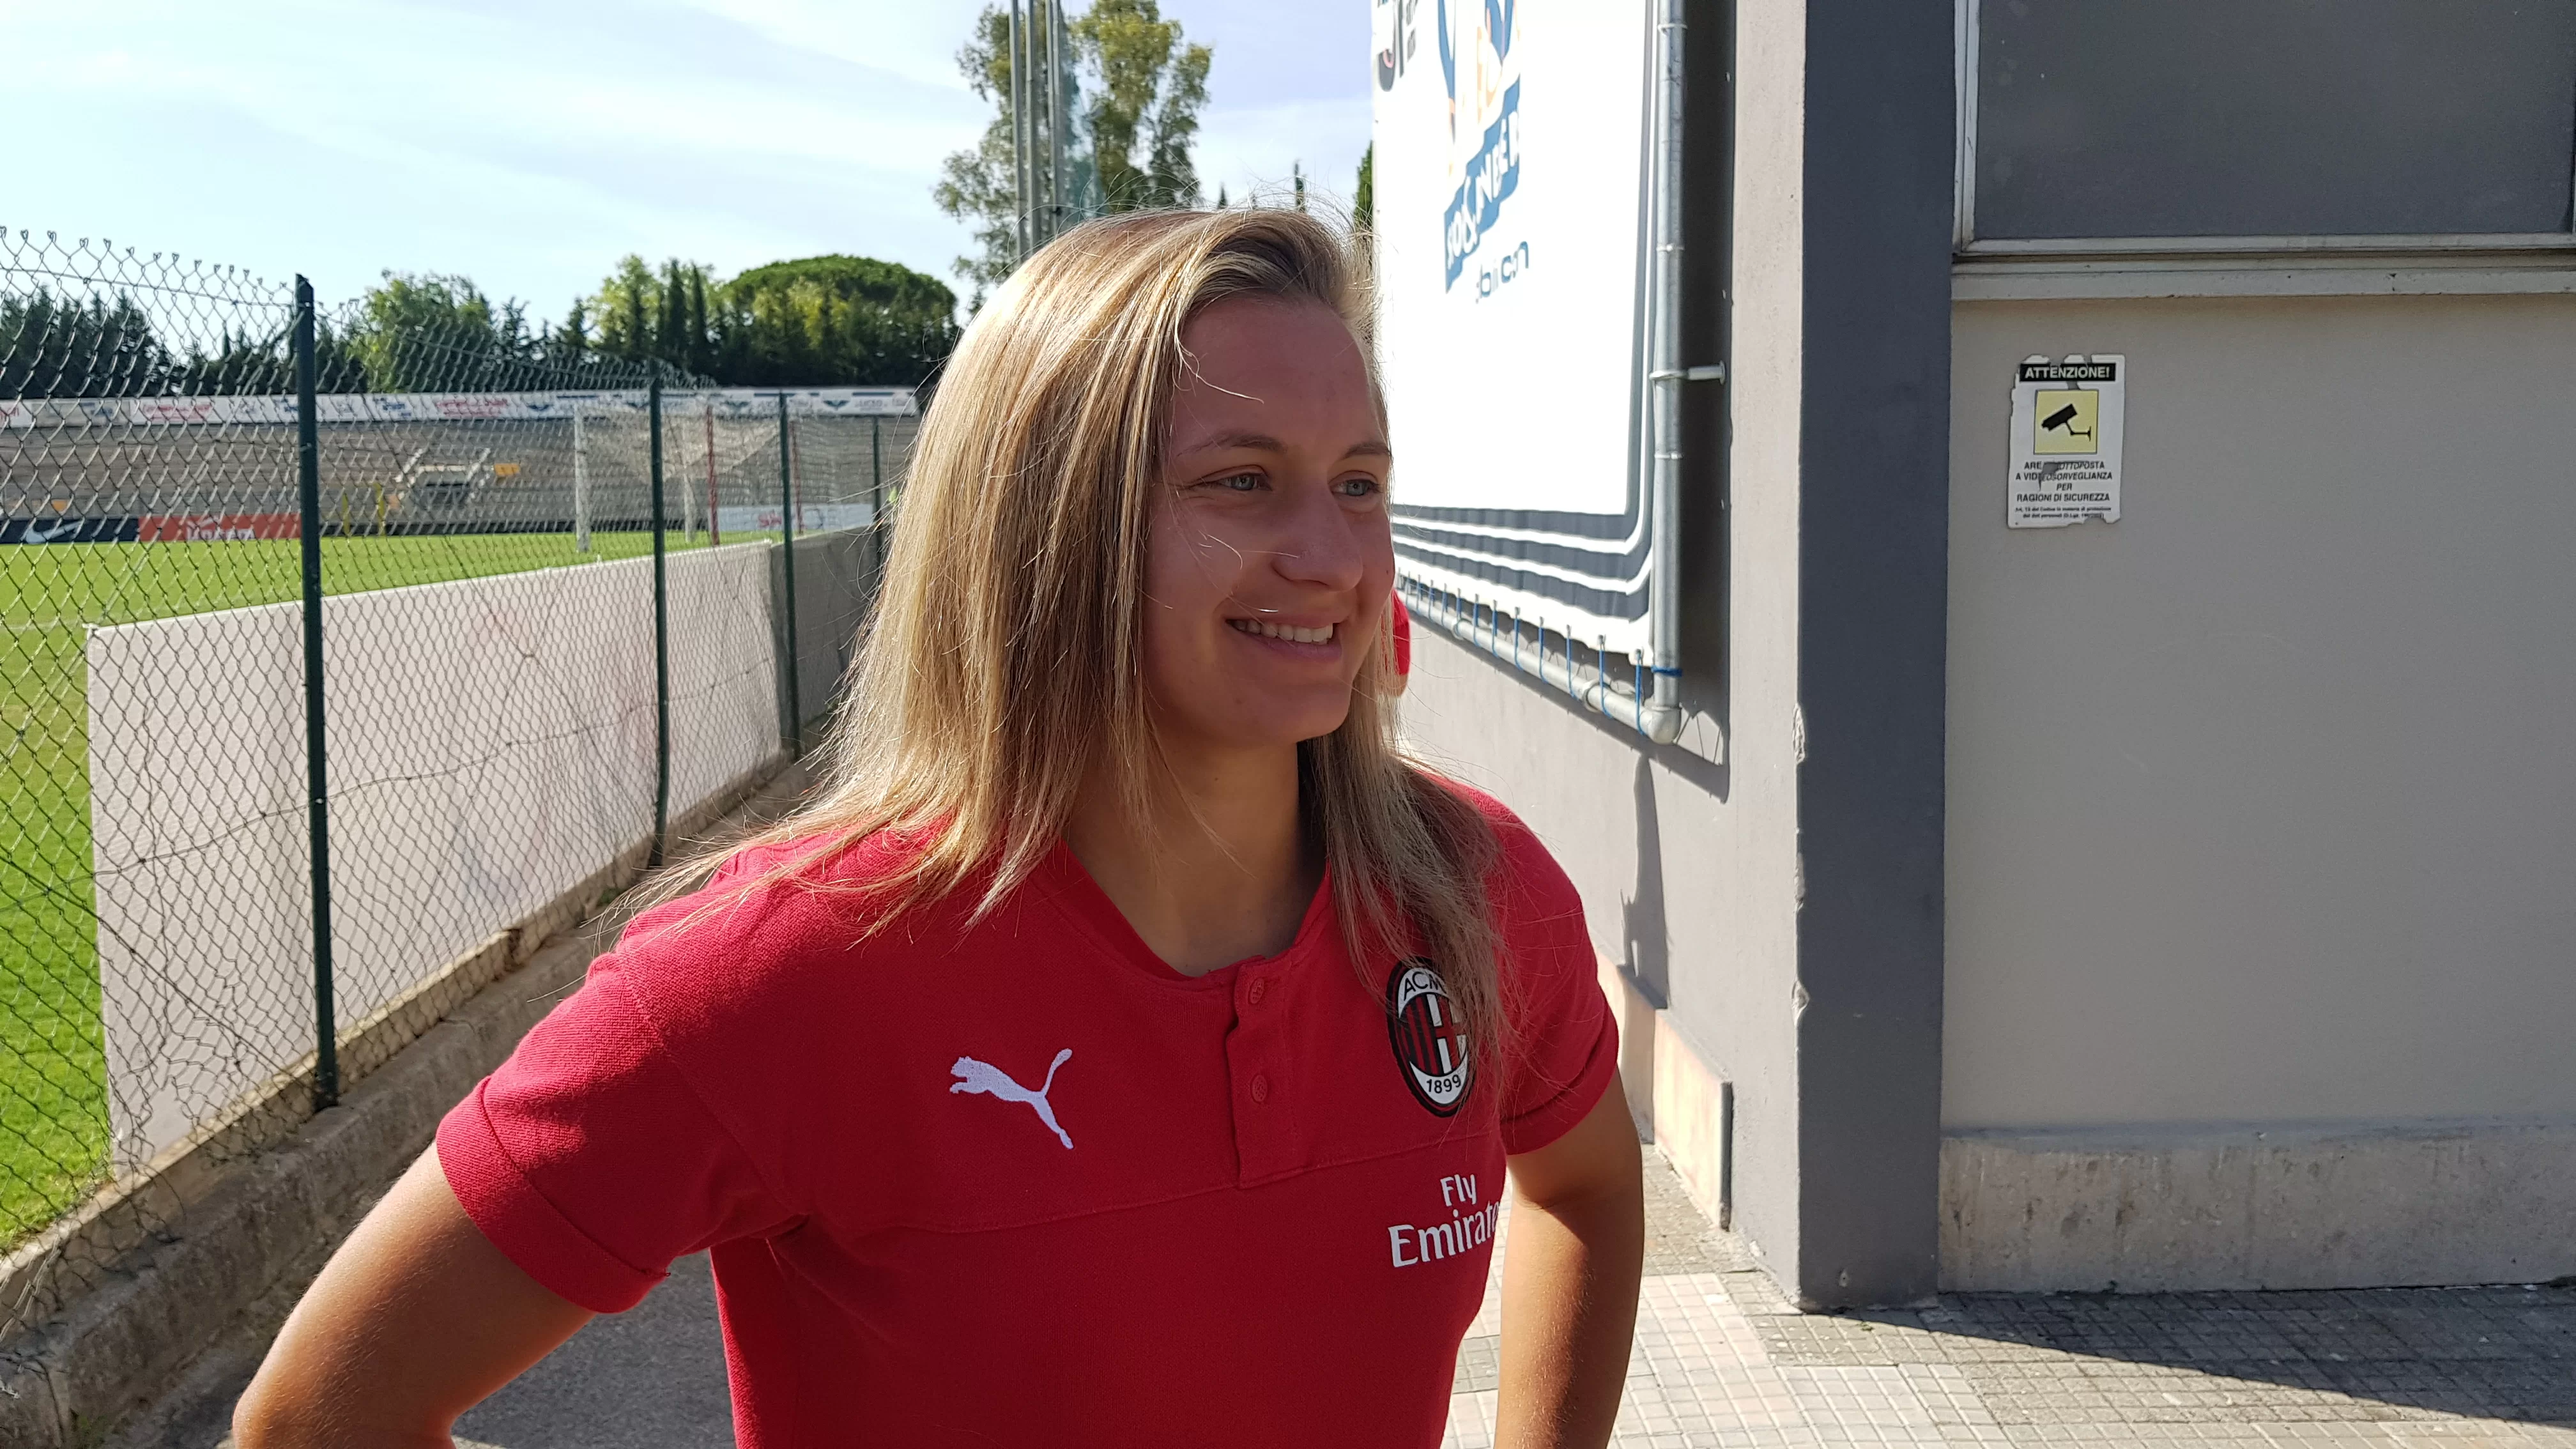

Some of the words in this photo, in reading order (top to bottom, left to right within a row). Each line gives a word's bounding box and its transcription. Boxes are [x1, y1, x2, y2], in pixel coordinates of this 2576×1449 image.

[2025, 366, 2110, 378] ATTENZIONE!
[2024, 461, 2043, 470] ARE
[2057, 461, 2104, 470] OTTOPOSTA
[2016, 493, 2052, 502] RAGIONI
[2064, 493, 2110, 502] SICUREZZA
[1427, 1074, 1462, 1094] 1899
[1440, 1174, 1477, 1206] Fly
[1388, 1200, 1501, 1268] Emirate
